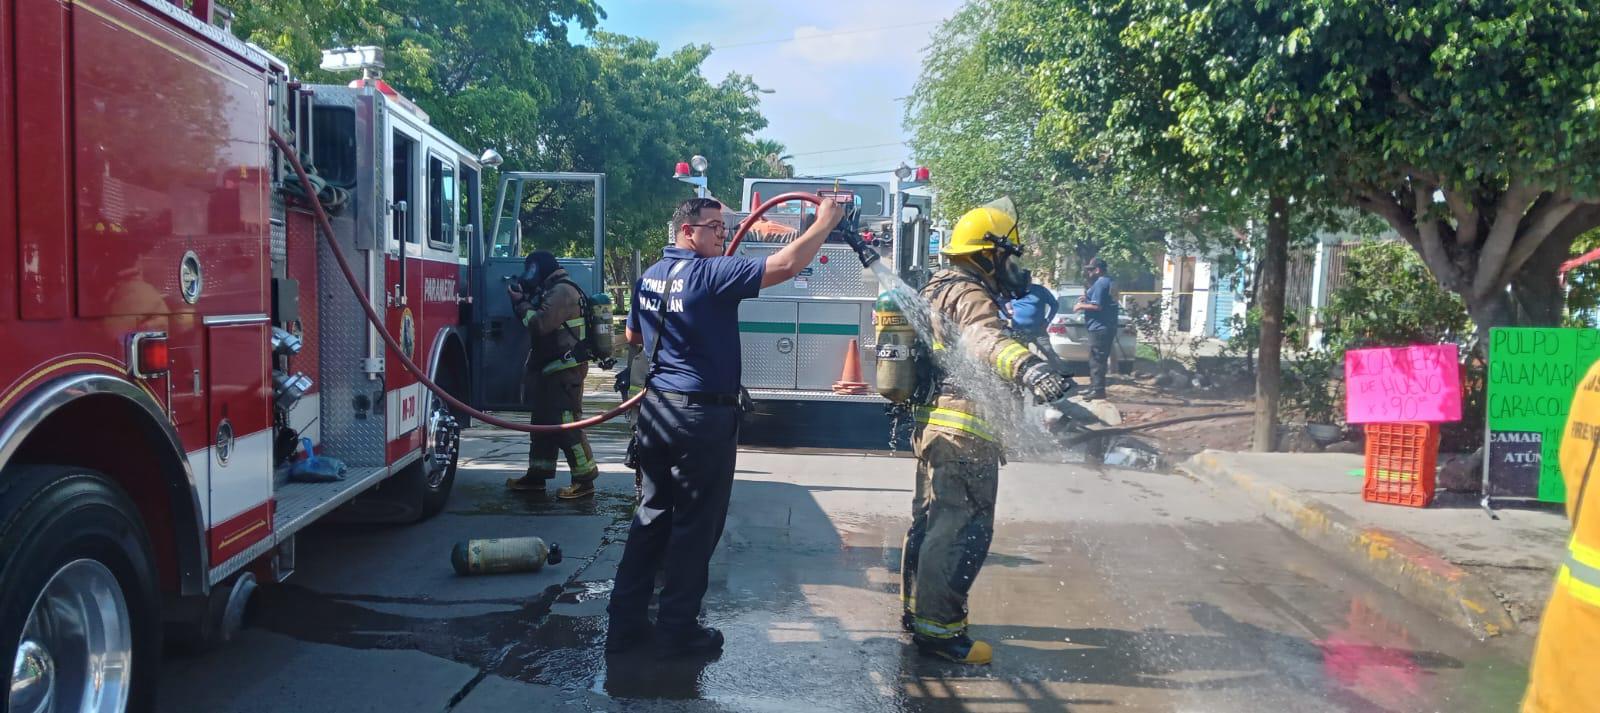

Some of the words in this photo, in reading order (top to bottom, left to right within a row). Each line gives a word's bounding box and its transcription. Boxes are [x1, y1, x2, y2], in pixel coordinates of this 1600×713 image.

[641, 278, 684, 293] BOMBEOS
[639, 296, 684, 313] MAZLÁN
[1494, 329, 1560, 356] PULPO
[1360, 379, 1376, 394] DE
[1381, 374, 1441, 397] HUEVO
[1490, 360, 1575, 389] CALAMAR
[1489, 393, 1569, 419] CARACOL
